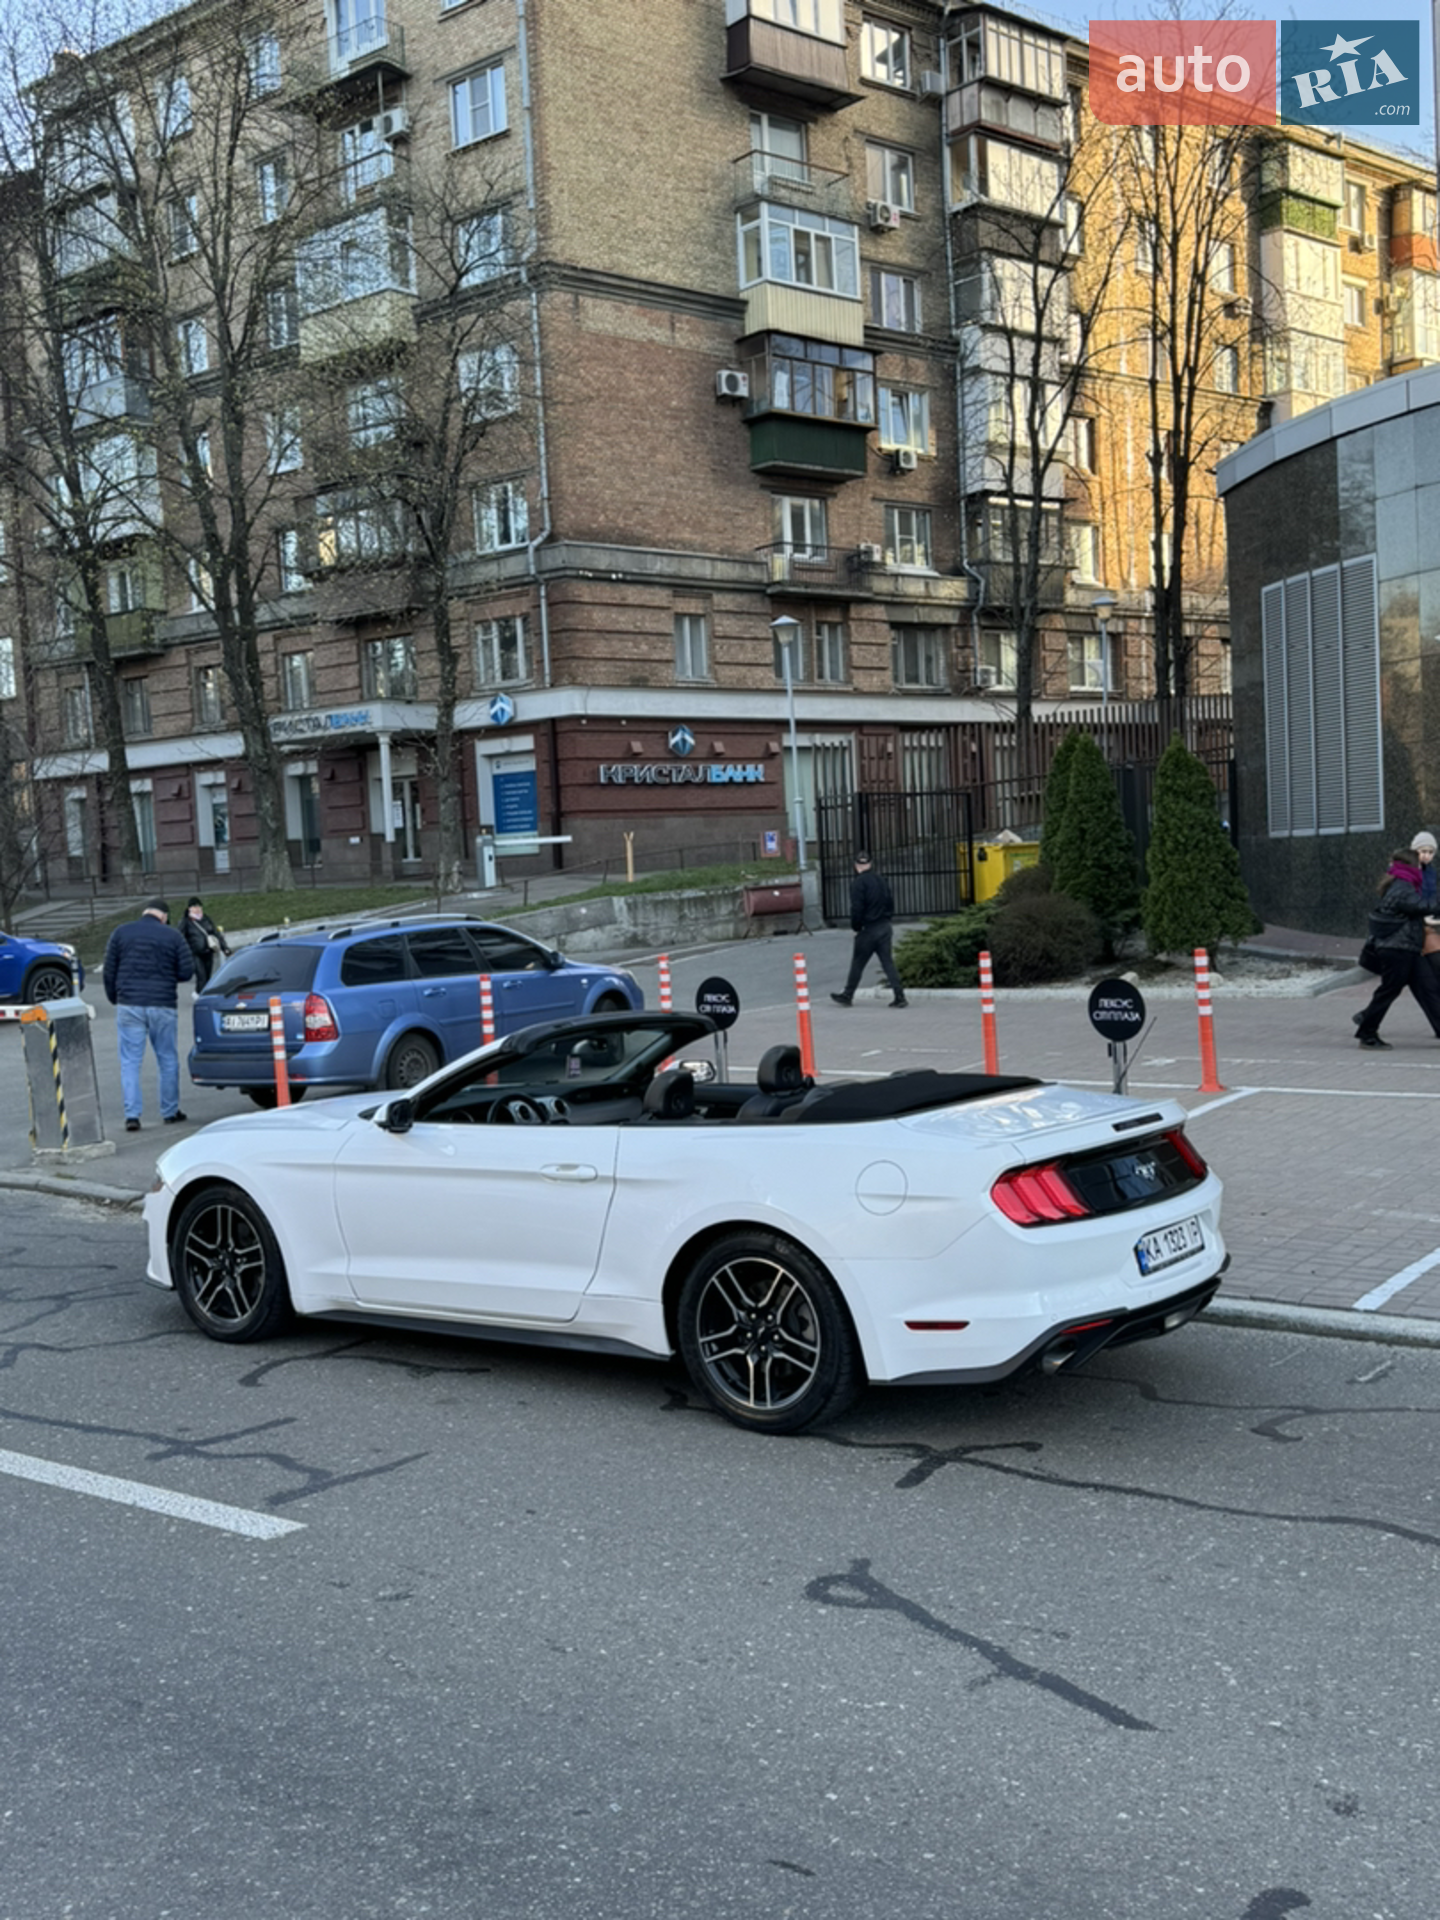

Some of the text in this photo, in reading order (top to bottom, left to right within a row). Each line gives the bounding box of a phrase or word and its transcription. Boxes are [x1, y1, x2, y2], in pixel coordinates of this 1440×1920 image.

[600, 764, 765, 784] КРИСТАЛБАНК
[1143, 1220, 1199, 1263] KA 1323 IP
